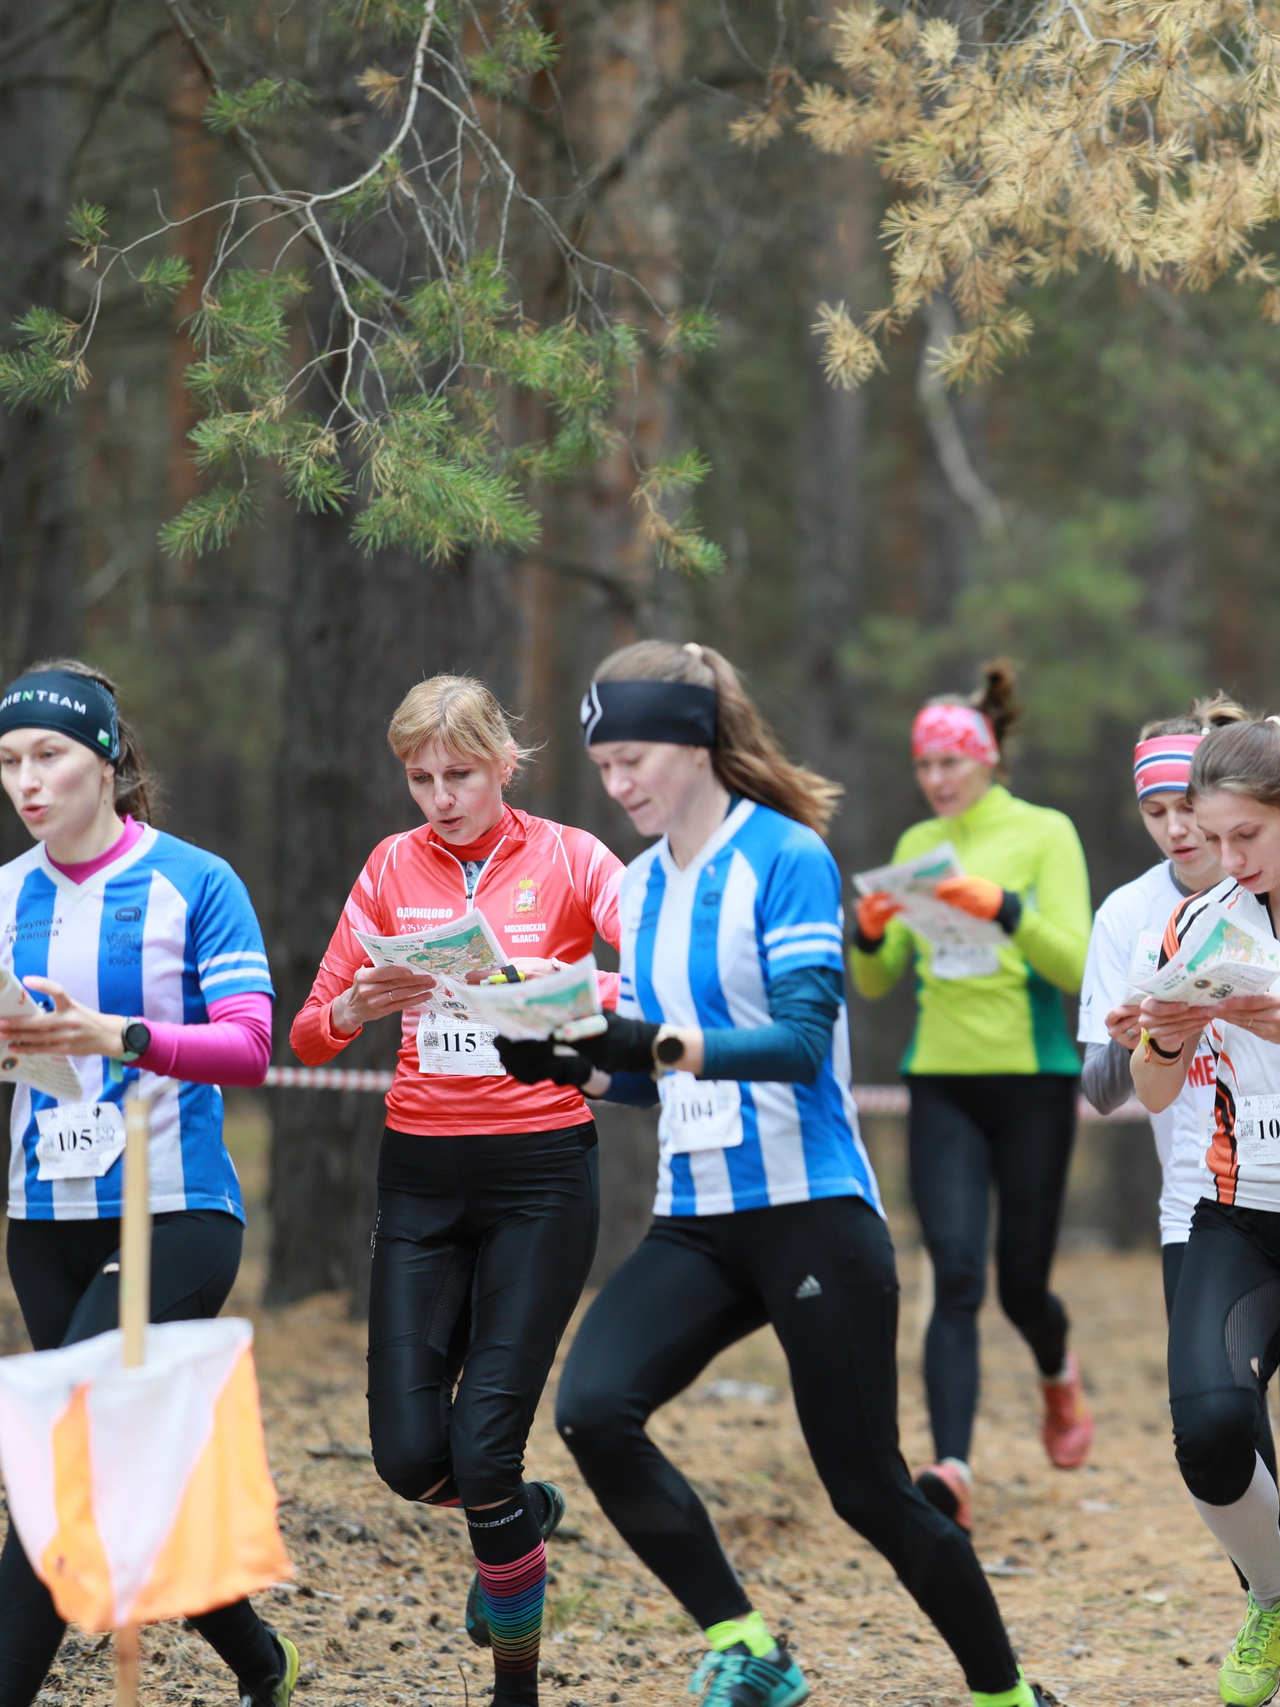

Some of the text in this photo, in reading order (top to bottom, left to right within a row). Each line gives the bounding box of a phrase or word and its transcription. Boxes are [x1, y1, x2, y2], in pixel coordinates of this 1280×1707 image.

[396, 906, 453, 920] ОДИНЦОВО
[504, 923, 546, 933] МОСКОВСКАЯ
[511, 934, 540, 943] ОБЛАСТЬ
[441, 1032, 477, 1053] 115
[681, 1099, 713, 1122] 104
[58, 1129, 93, 1152] 105
